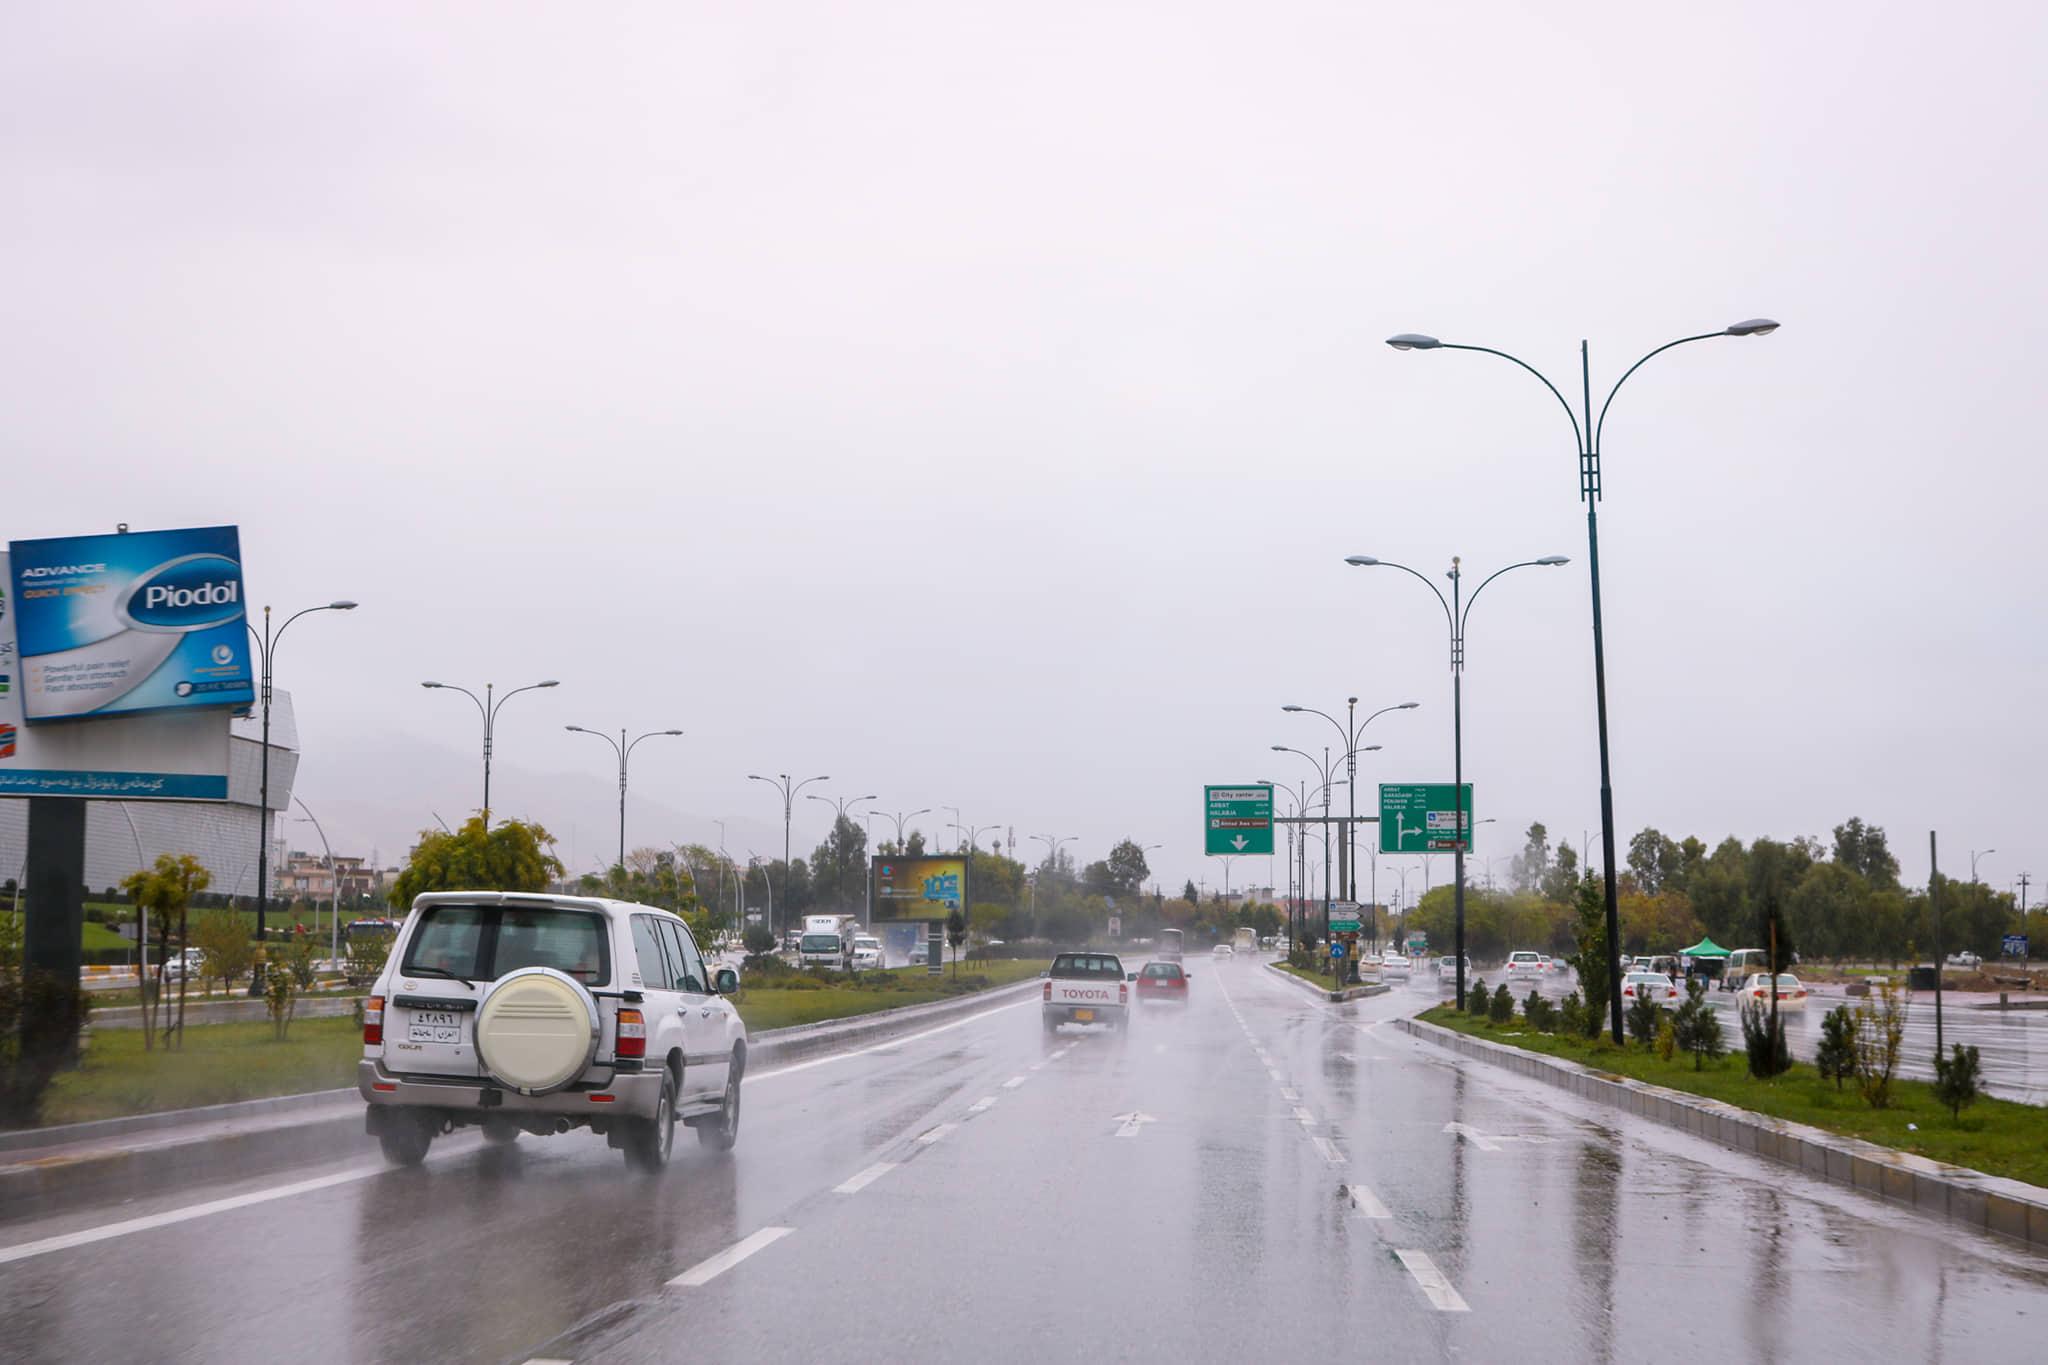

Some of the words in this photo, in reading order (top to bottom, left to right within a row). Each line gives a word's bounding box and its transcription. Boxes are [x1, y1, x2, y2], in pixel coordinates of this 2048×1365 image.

[21, 563, 105, 577] ADVANCE
[146, 581, 237, 609] Piodol
[1062, 988, 1109, 1000] TOYOTA
